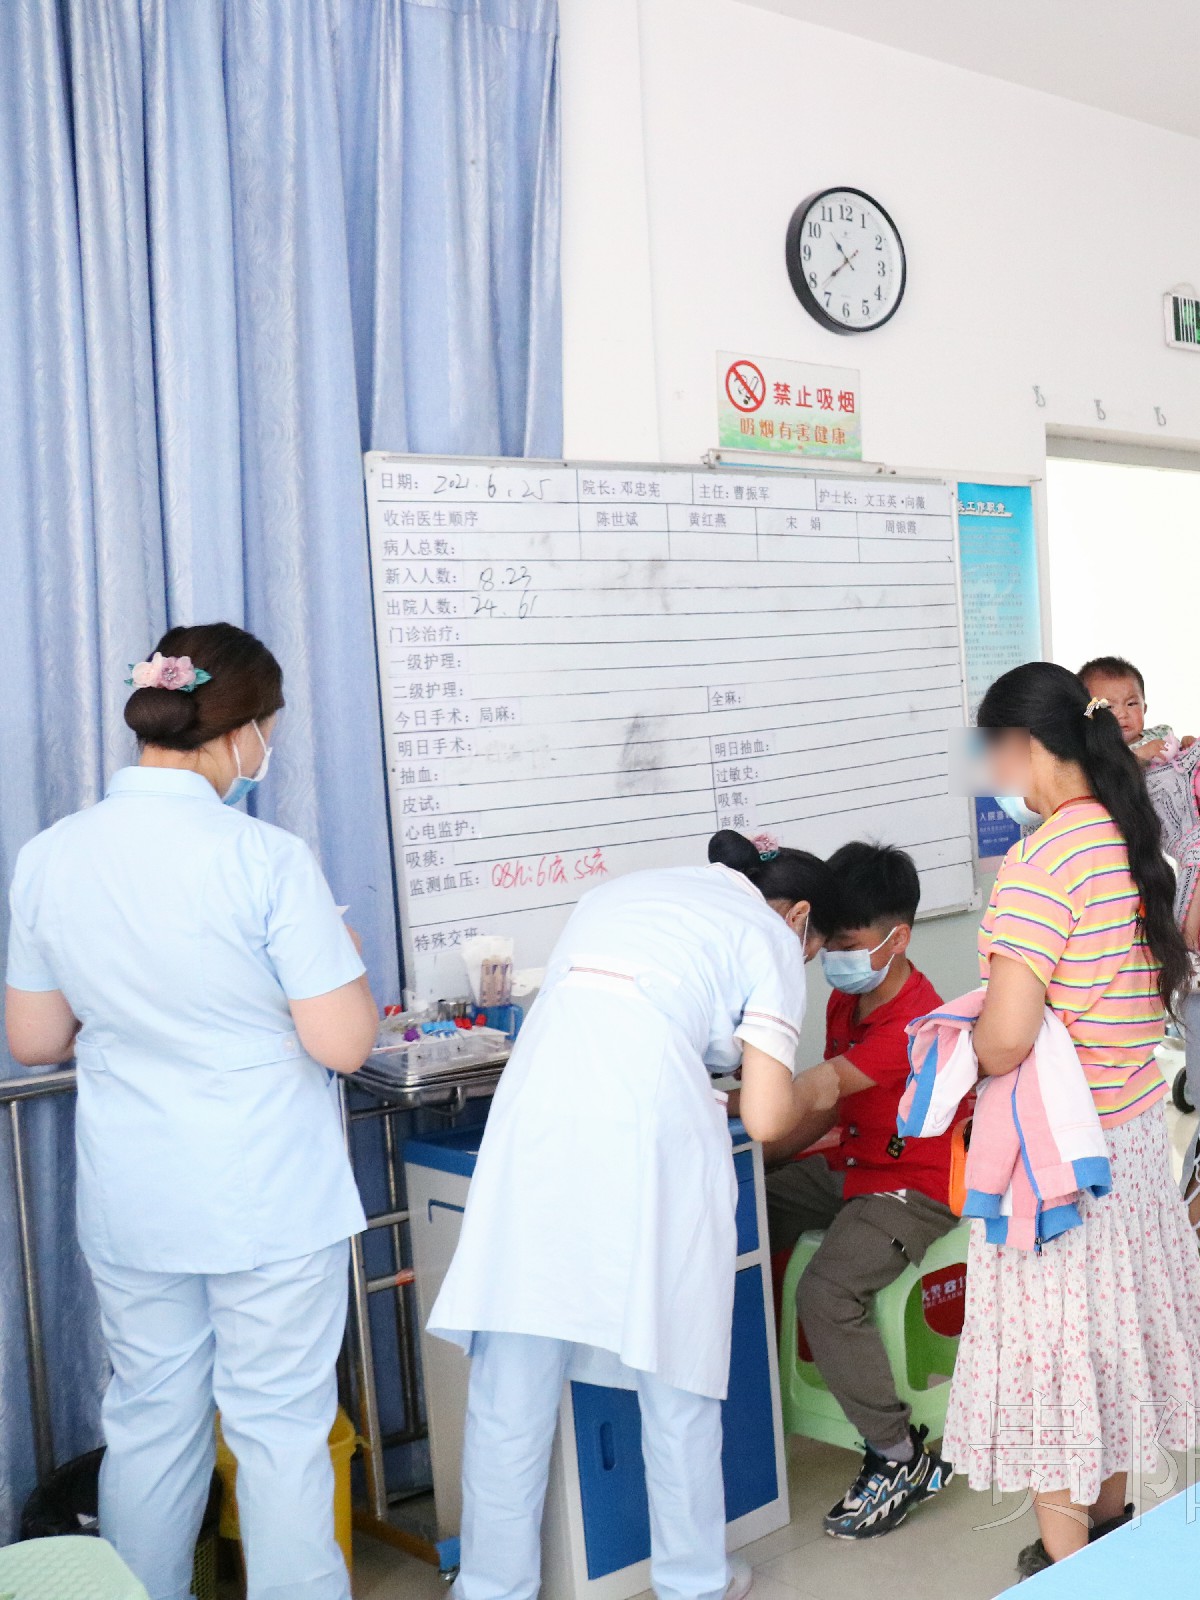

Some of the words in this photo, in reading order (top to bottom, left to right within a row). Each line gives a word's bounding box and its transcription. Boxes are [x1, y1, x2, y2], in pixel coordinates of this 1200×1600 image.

[821, 205, 833, 223] 11
[839, 204, 853, 222] 12
[860, 213, 866, 229] 1
[808, 222, 821, 239] 10
[875, 235, 882, 251] 2
[803, 244, 811, 261] 9
[877, 260, 886, 277] 3
[809, 272, 818, 289] 8
[823, 291, 832, 308] 7
[874, 284, 882, 301] 4
[842, 302, 850, 318] 6
[861, 299, 870, 316] 5
[773, 382, 855, 413] 禁止吸烟
[740, 417, 846, 445] 吸烟有害健康
[381, 473, 419, 490] 日期：
[384, 510, 479, 527] 收治医生顺序
[596, 511, 639, 527] 陈世斌
[688, 512, 727, 528] 黄红燕
[384, 539, 455, 556] 病人总数：
[386, 598, 458, 616] 出院人数：
[389, 625, 460, 643] 门诊治疗：
[390, 653, 462, 671] 一级护理：
[393, 681, 464, 700] 二级护理：
[712, 689, 742, 707] 全麻：
[398, 737, 472, 756] 明日手术：
[715, 738, 769, 758] 明日抽血：
[400, 767, 438, 785] 抽血：
[716, 765, 758, 784] 过敏史：
[402, 796, 440, 815] 皮试：
[718, 791, 748, 808] 吸氧：
[405, 820, 475, 841] 心电监护：
[410, 869, 480, 897] 监测血压：
